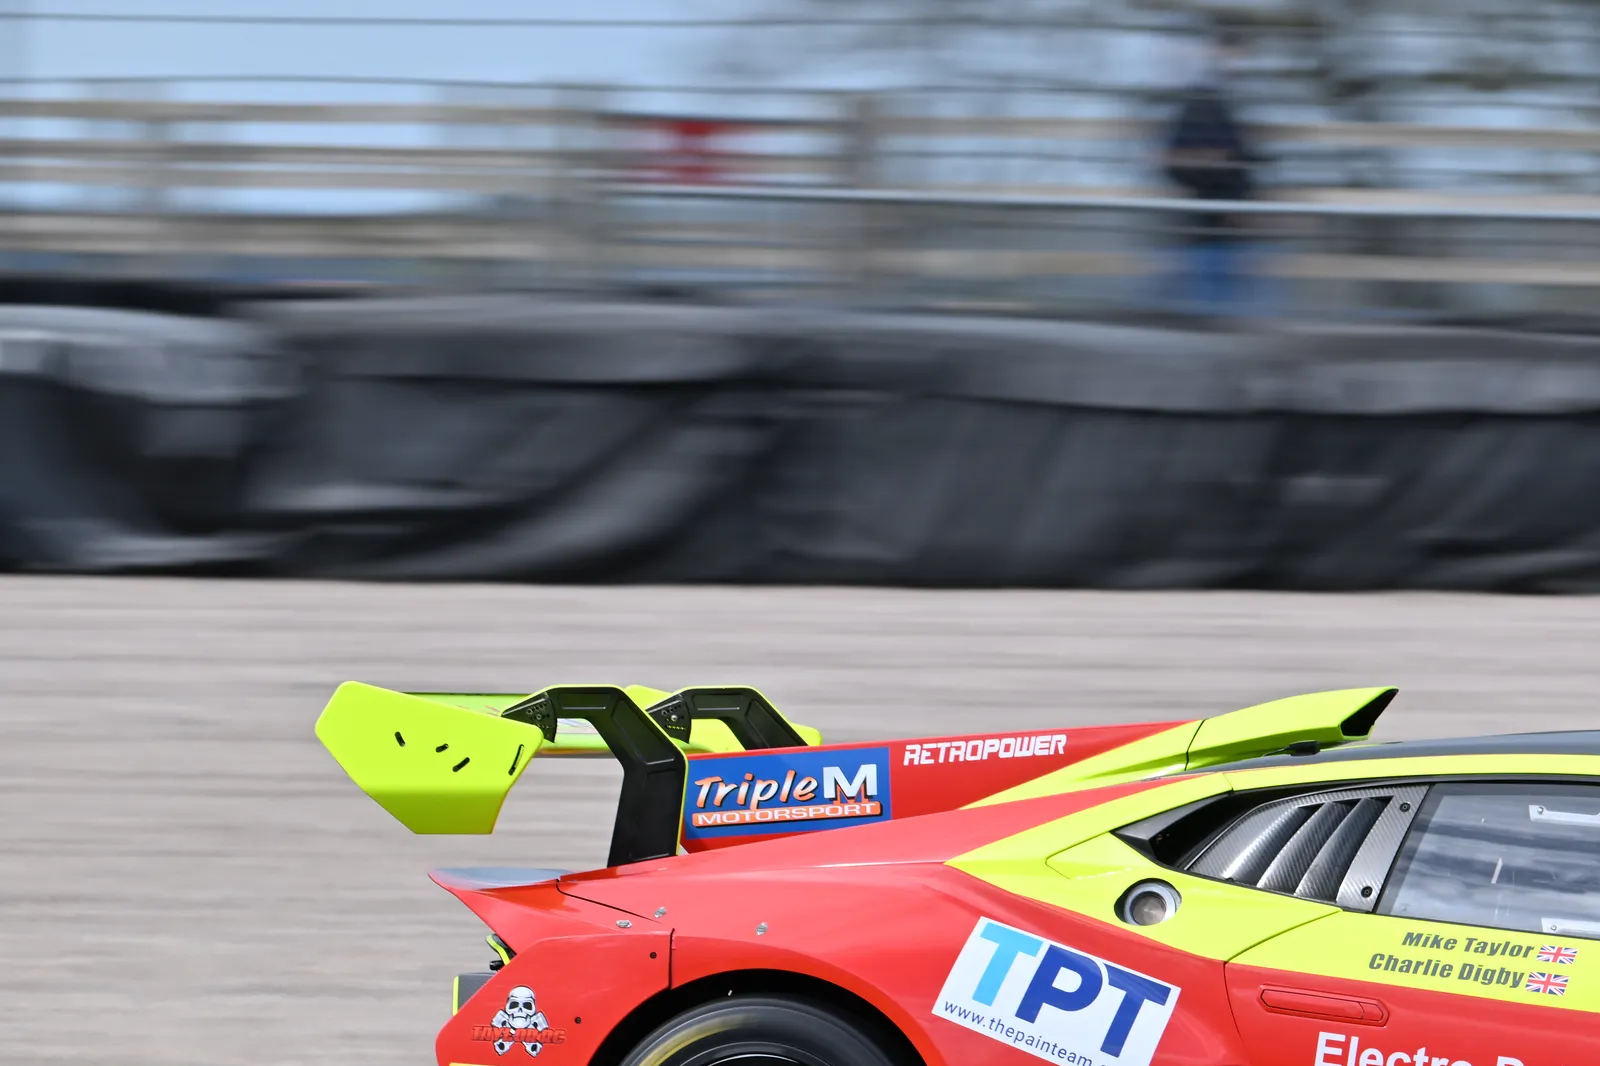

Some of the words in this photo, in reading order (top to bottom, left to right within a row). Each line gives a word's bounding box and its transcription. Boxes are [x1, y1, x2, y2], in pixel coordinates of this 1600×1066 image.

[903, 734, 1067, 766] RETROPOWER
[697, 803, 876, 825] MOTORSPORT
[1401, 932, 1458, 950] Mike
[1464, 937, 1535, 958] Taylor
[1368, 953, 1454, 978] Charlie
[1457, 963, 1525, 988] Digby
[971, 921, 1172, 1058] TPT
